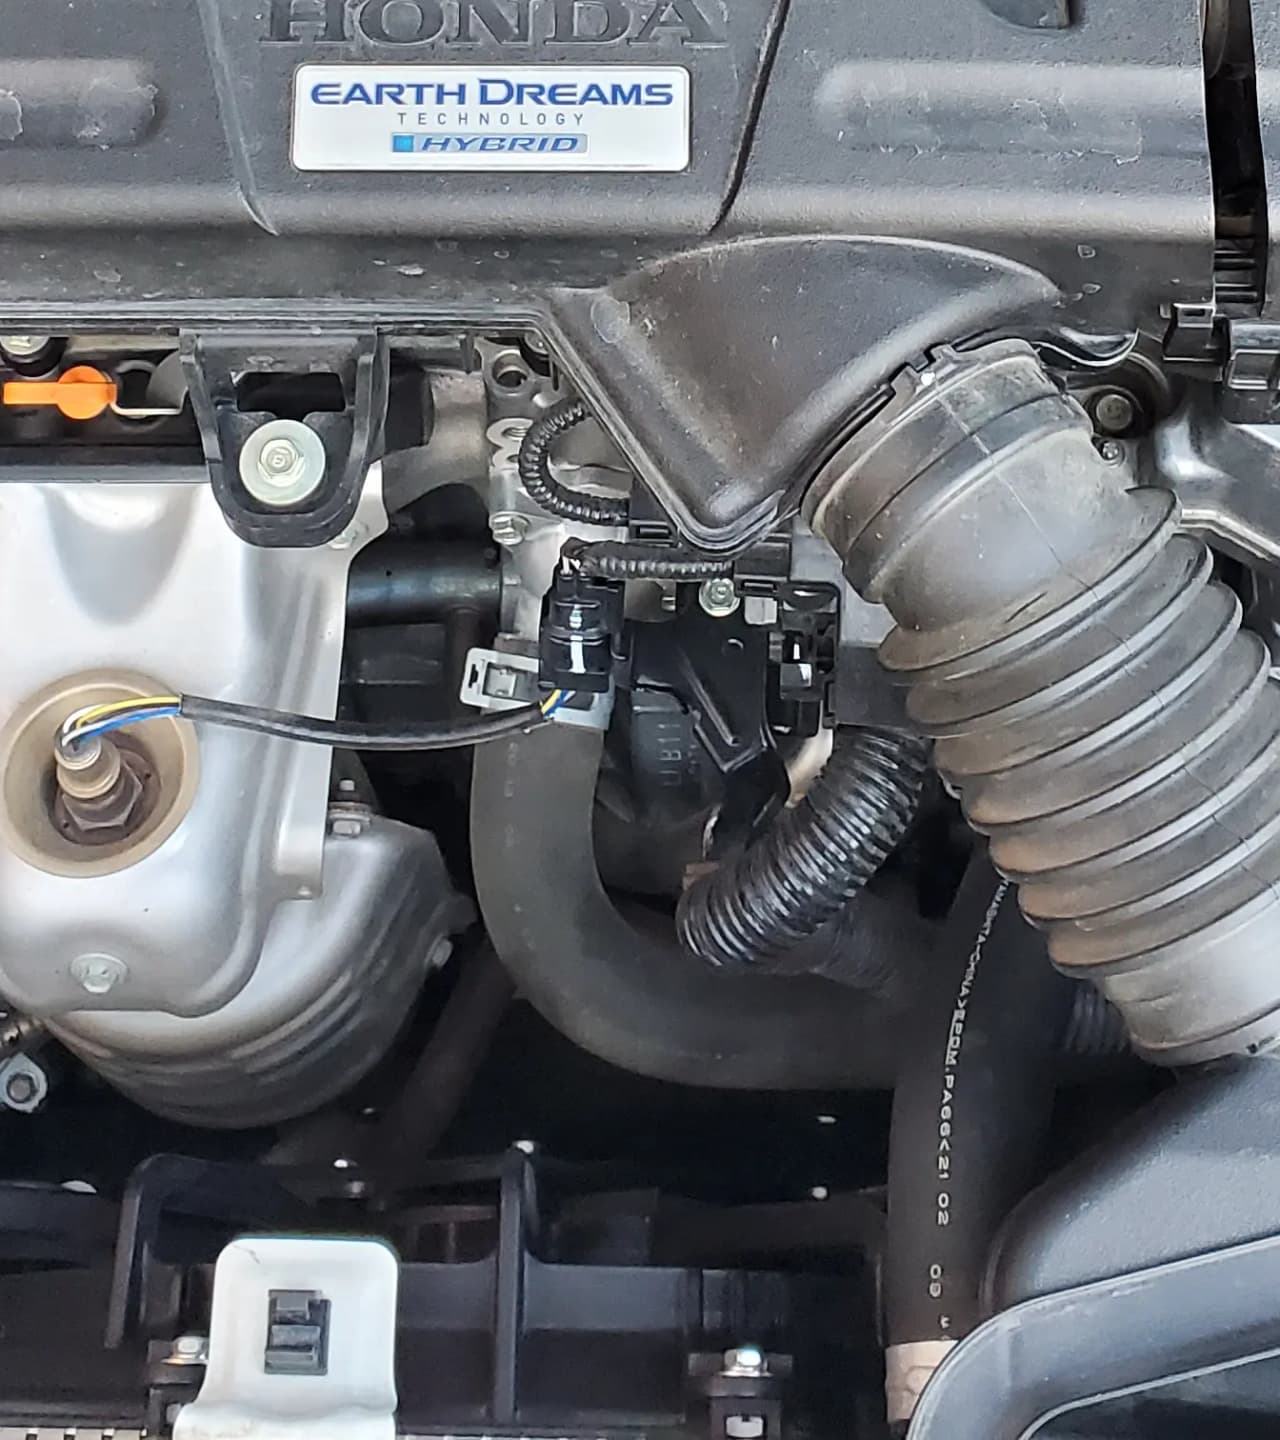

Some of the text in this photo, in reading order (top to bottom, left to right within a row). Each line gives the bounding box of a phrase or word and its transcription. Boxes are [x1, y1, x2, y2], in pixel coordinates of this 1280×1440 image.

[310, 78, 673, 107] EARTH DREAMS
[397, 112, 585, 126] TECHNOLOGY
[420, 136, 580, 153] HYBRID
